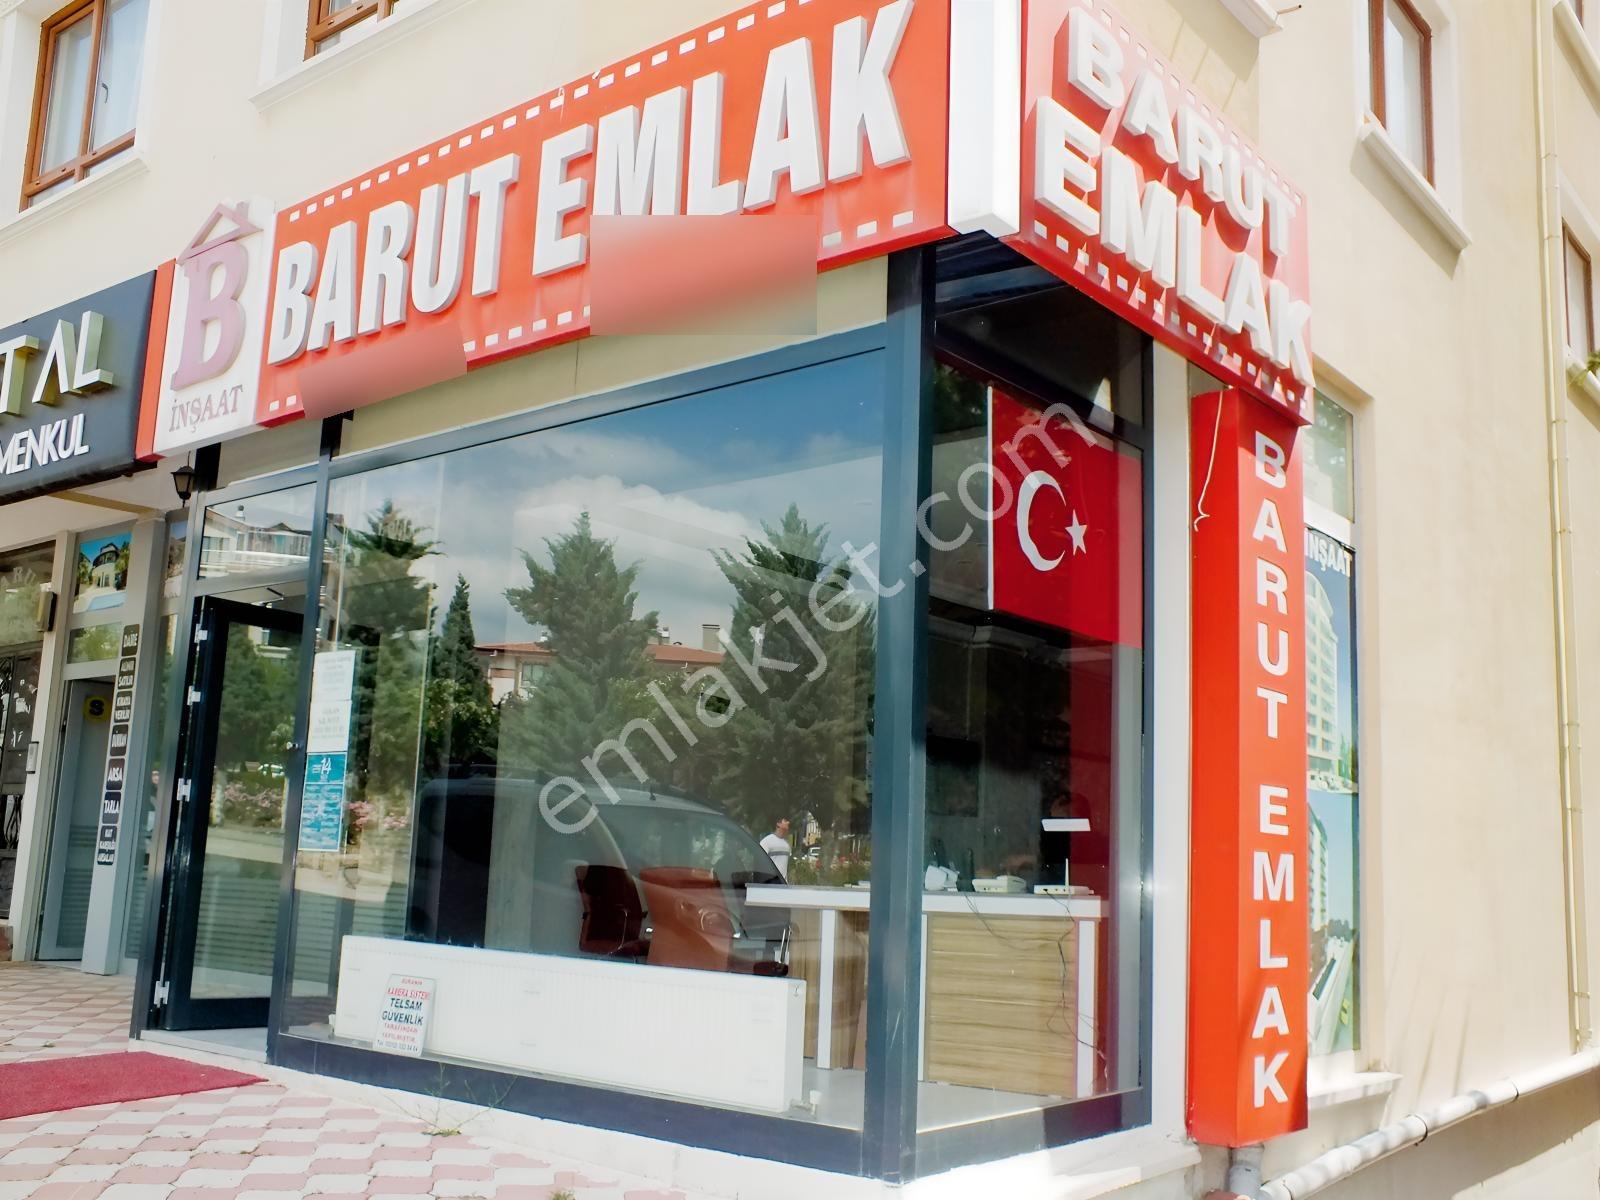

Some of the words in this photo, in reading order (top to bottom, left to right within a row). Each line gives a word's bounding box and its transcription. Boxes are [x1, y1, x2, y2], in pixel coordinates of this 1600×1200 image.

[267, 153, 520, 365] BARUT
[532, 0, 915, 277] EMLAK
[1034, 96, 1315, 388] EMLAK
[1064, 7, 1296, 257] BARUT
[168, 384, 244, 434] İNŞAAT
[171, 241, 248, 391] B
[1252, 430, 1289, 739] BARUT
[389, 997, 423, 1011] TELSAM
[1251, 784, 1295, 1109] EMLAK
